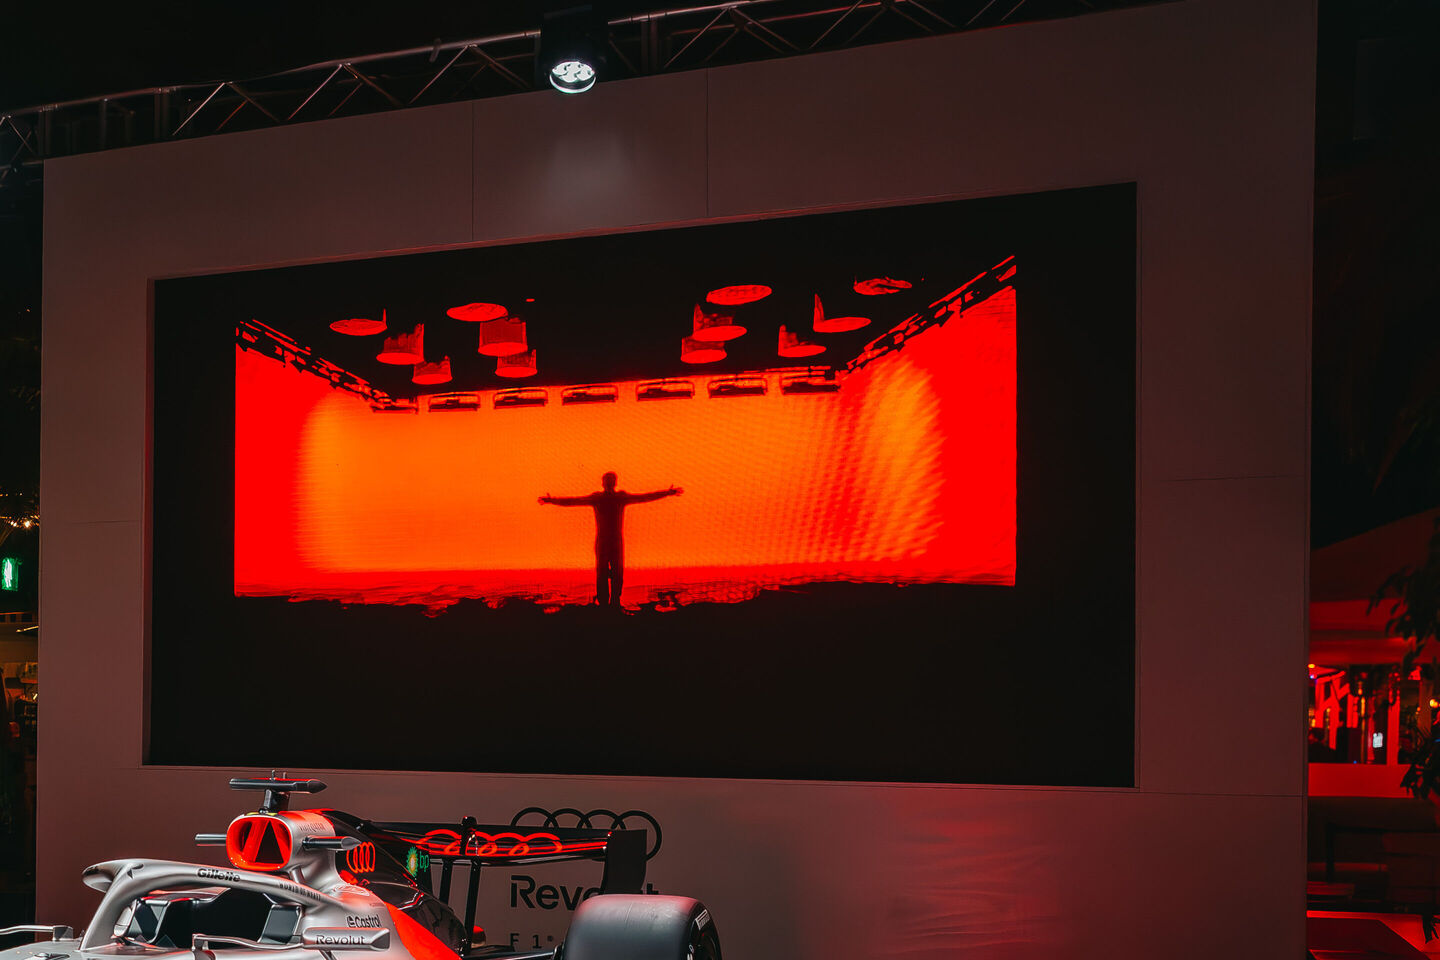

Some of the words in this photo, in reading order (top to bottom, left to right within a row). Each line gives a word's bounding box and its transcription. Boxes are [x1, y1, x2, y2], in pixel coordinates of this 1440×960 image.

[419, 852, 430, 872] bp
[197, 867, 241, 883] Gillette
[316, 934, 365, 945] Revolut
